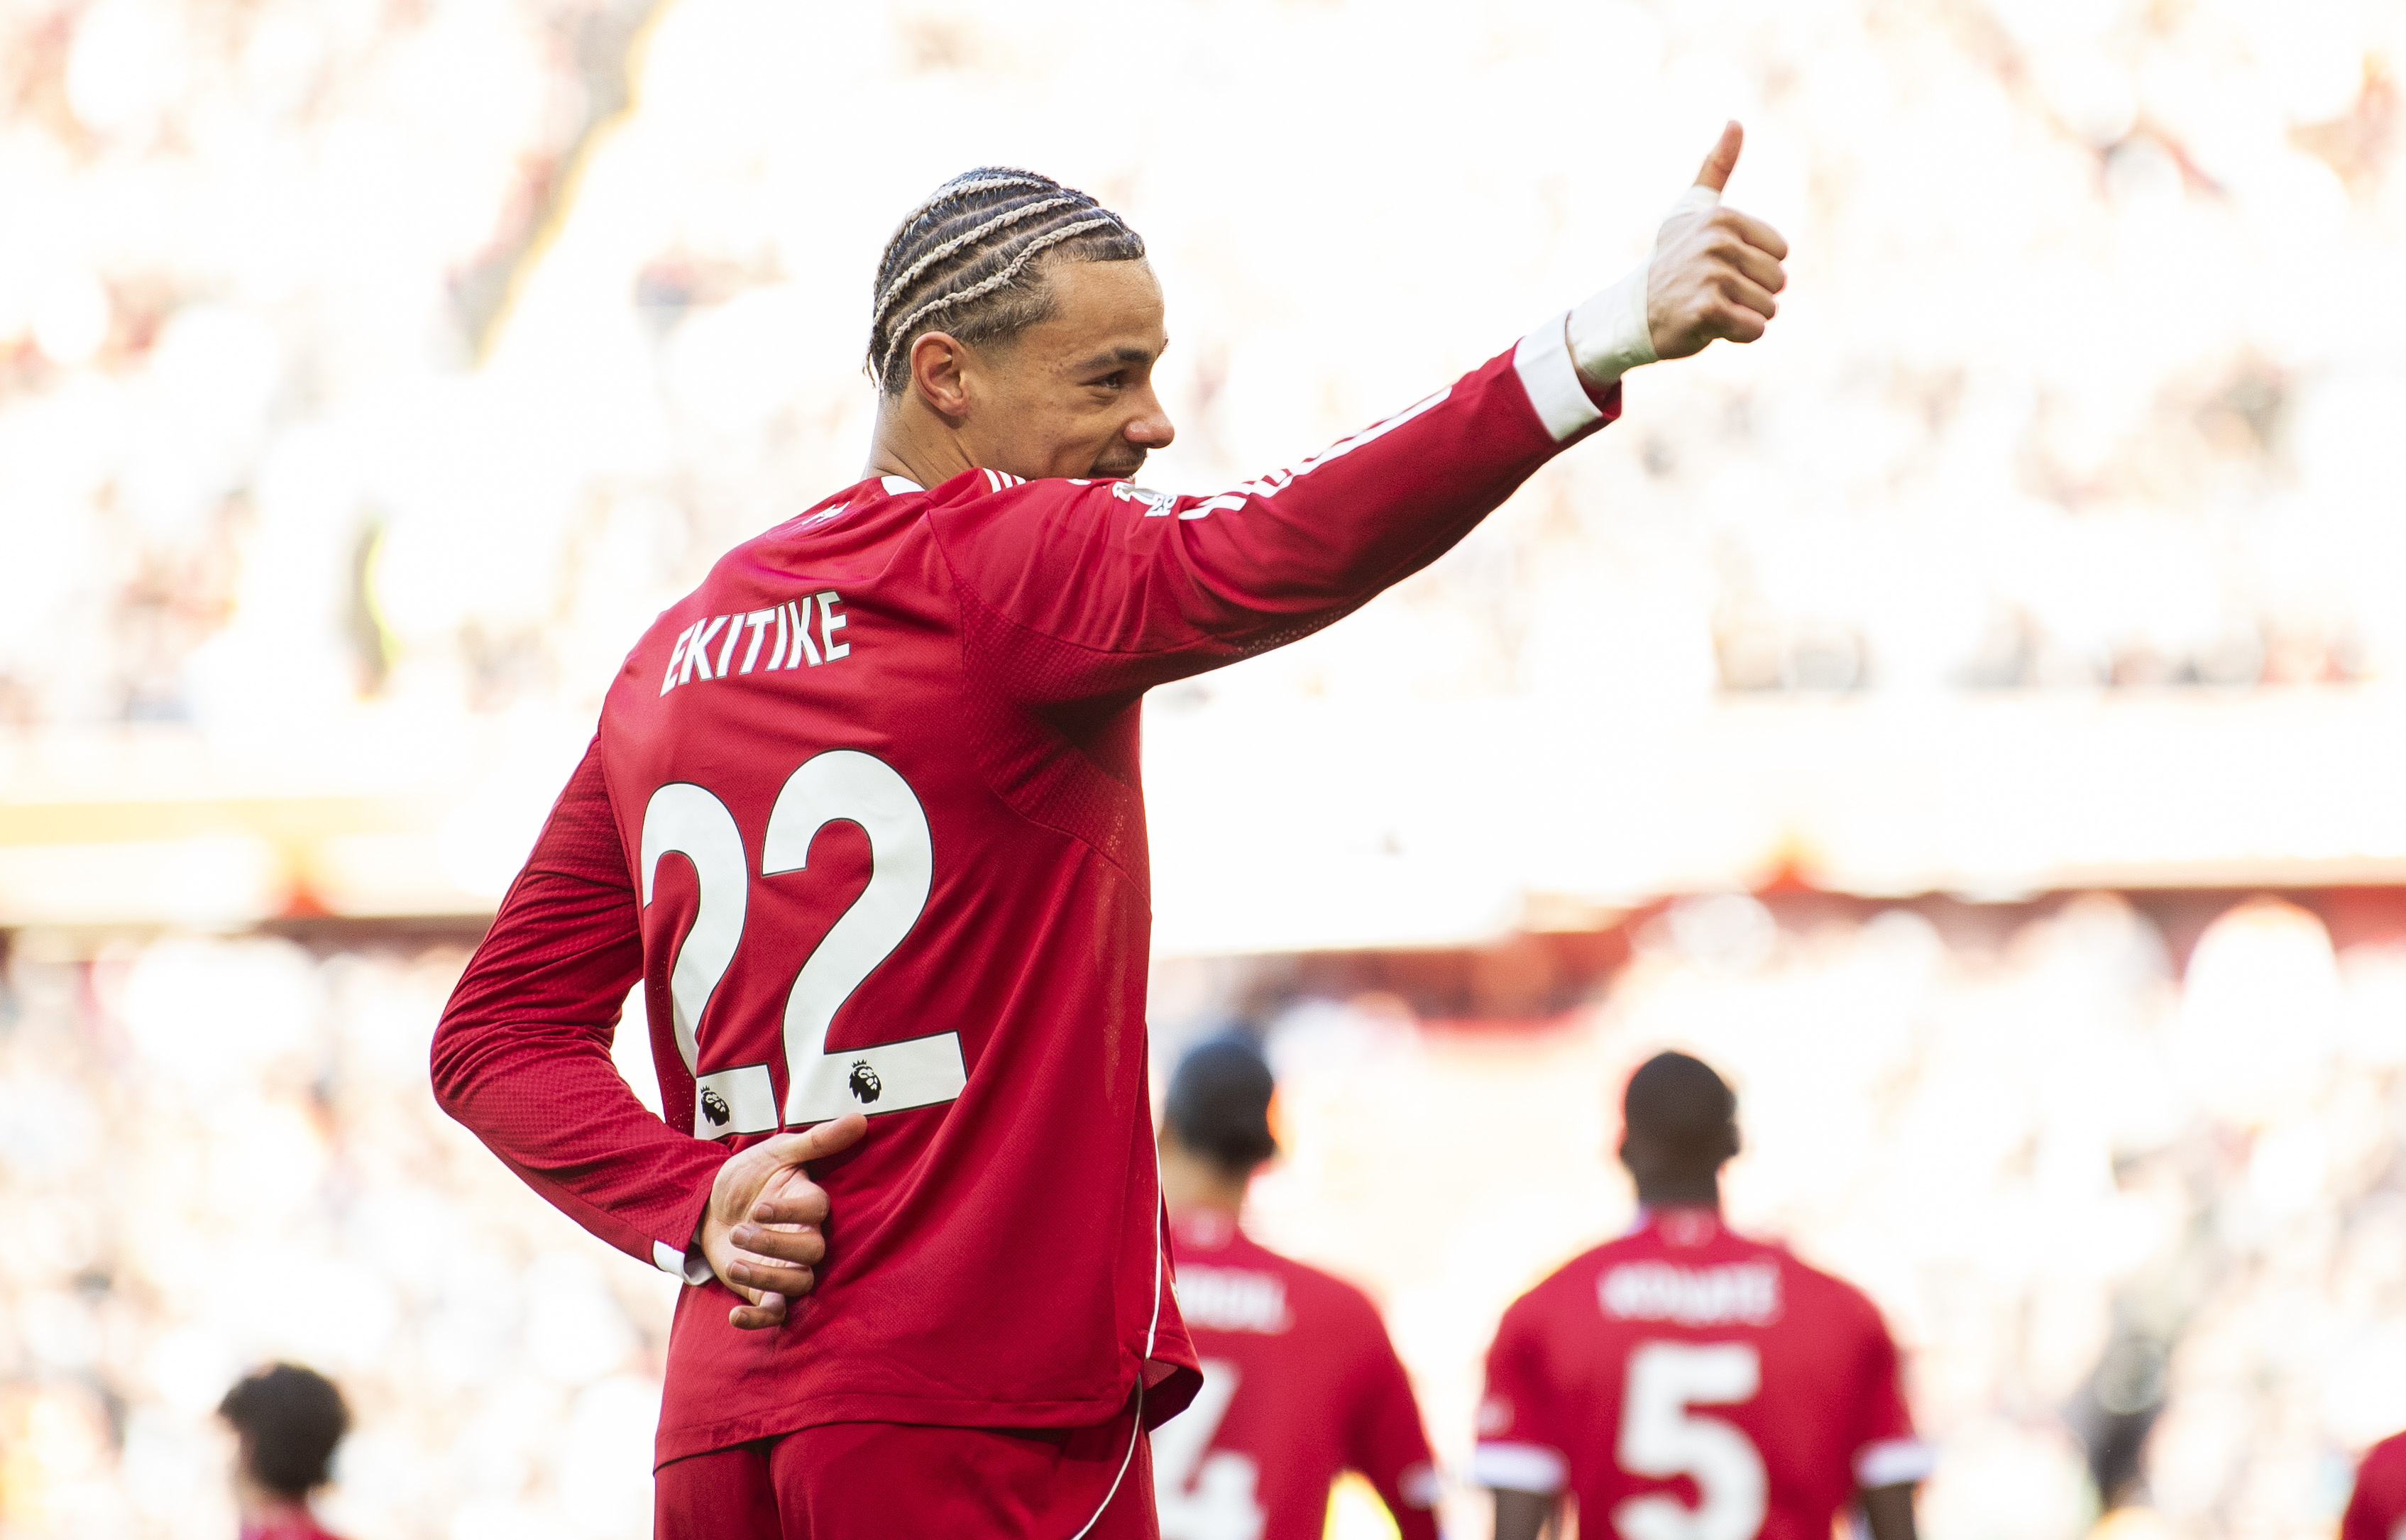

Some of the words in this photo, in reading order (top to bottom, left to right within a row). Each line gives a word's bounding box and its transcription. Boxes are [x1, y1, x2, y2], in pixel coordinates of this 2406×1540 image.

[659, 589, 851, 698] EKITIKE
[640, 749, 968, 1139] 22
[1611, 1340, 1770, 1540] 5
